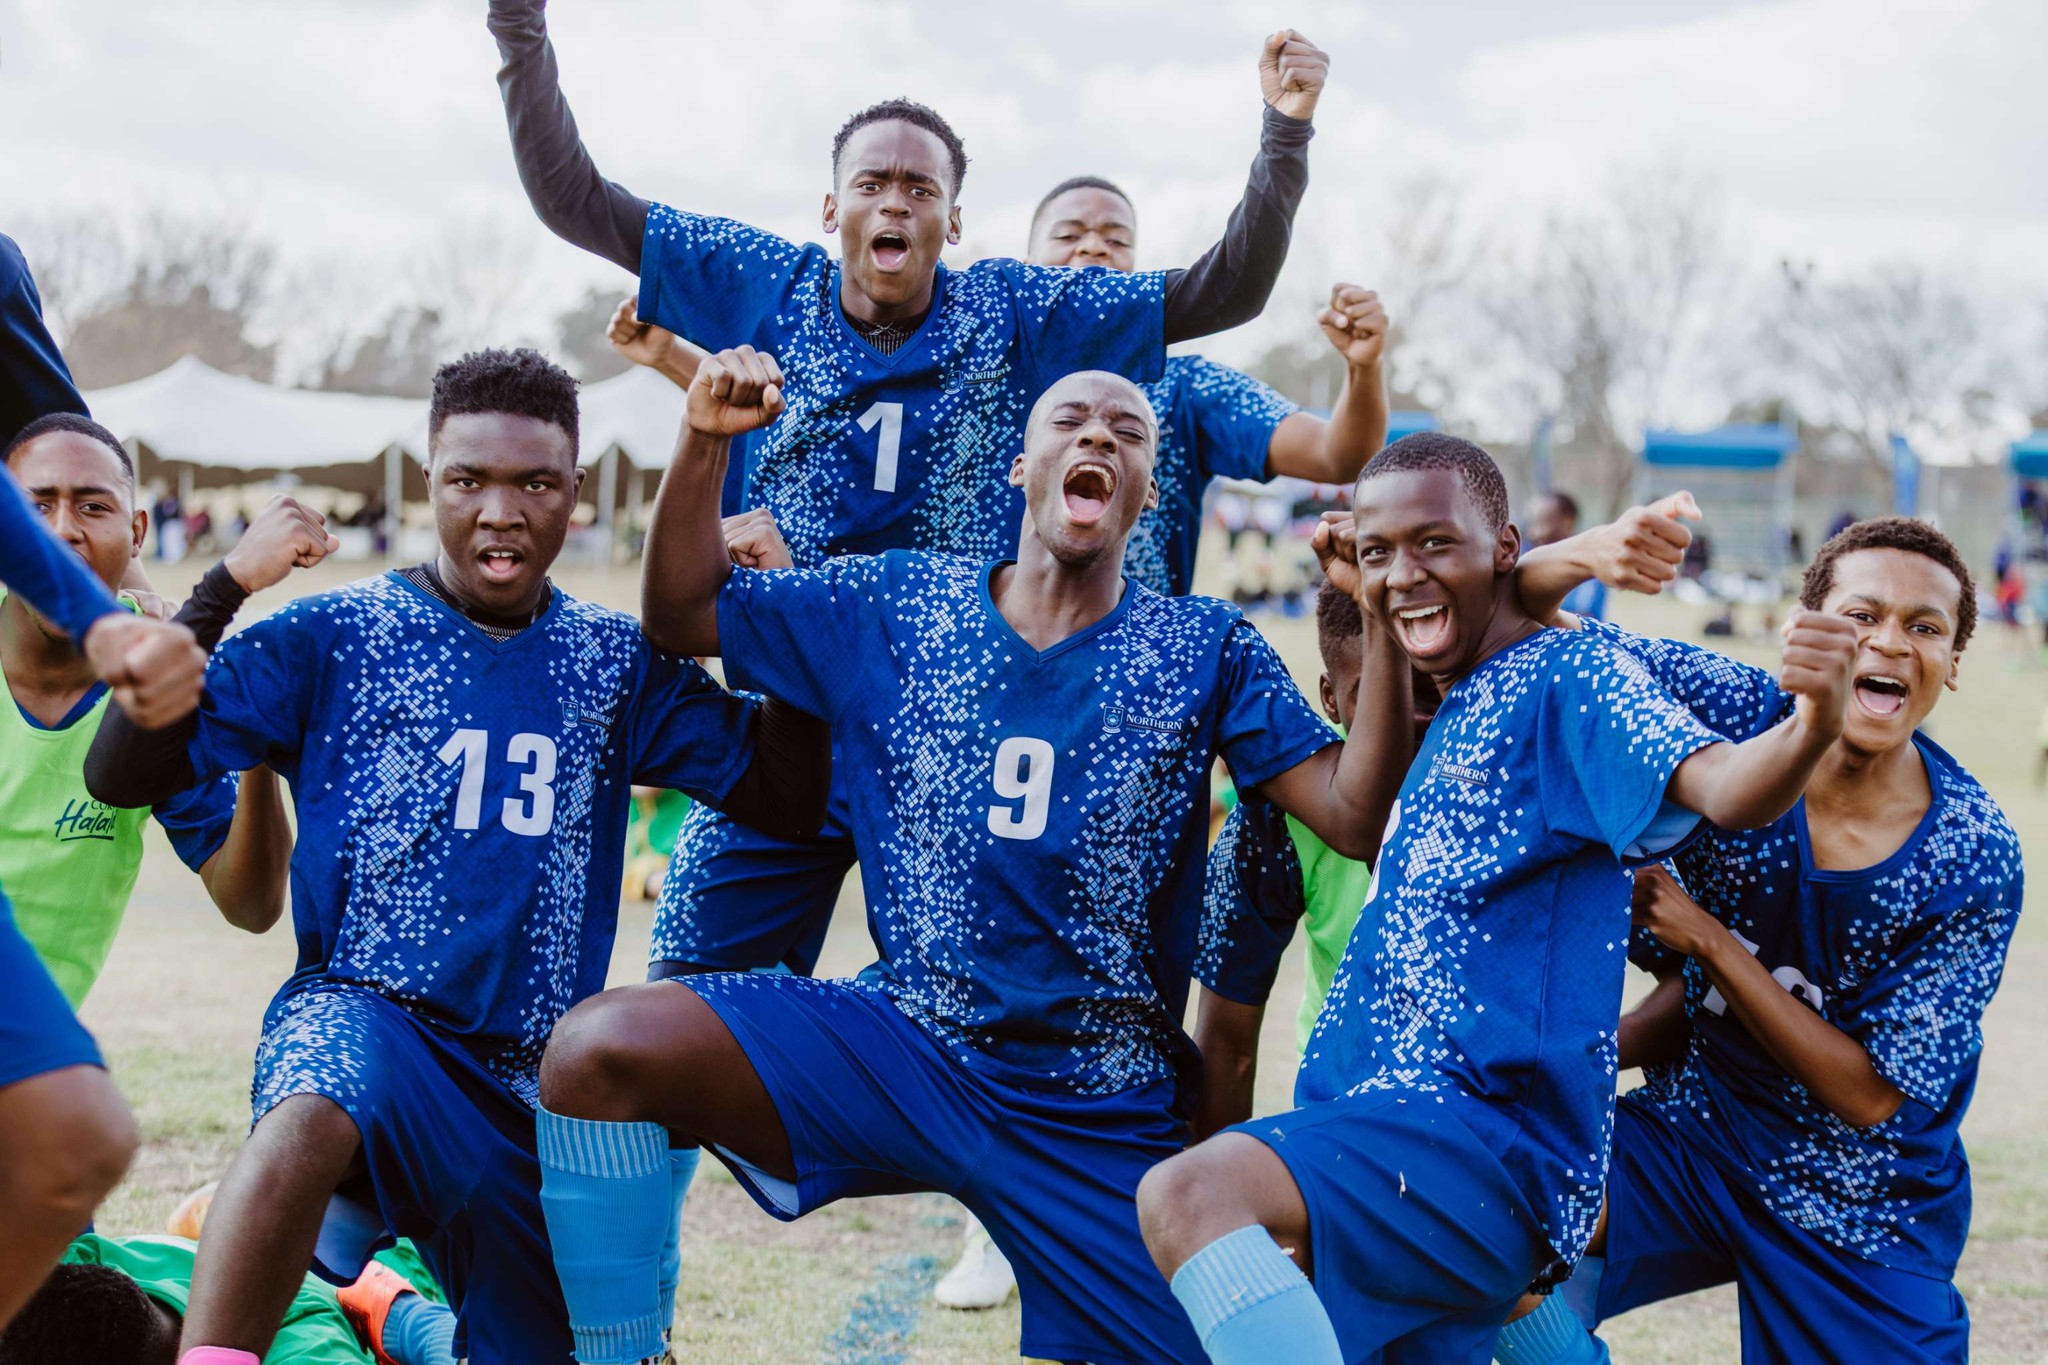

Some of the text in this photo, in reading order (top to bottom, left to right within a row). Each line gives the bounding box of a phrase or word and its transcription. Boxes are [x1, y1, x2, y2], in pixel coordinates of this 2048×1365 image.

[856, 401, 903, 493] 1
[1126, 713, 1184, 730] NORTHERN
[436, 728, 557, 837] 13
[987, 736, 1055, 841] 9
[1442, 763, 1489, 783] NORTHERN
